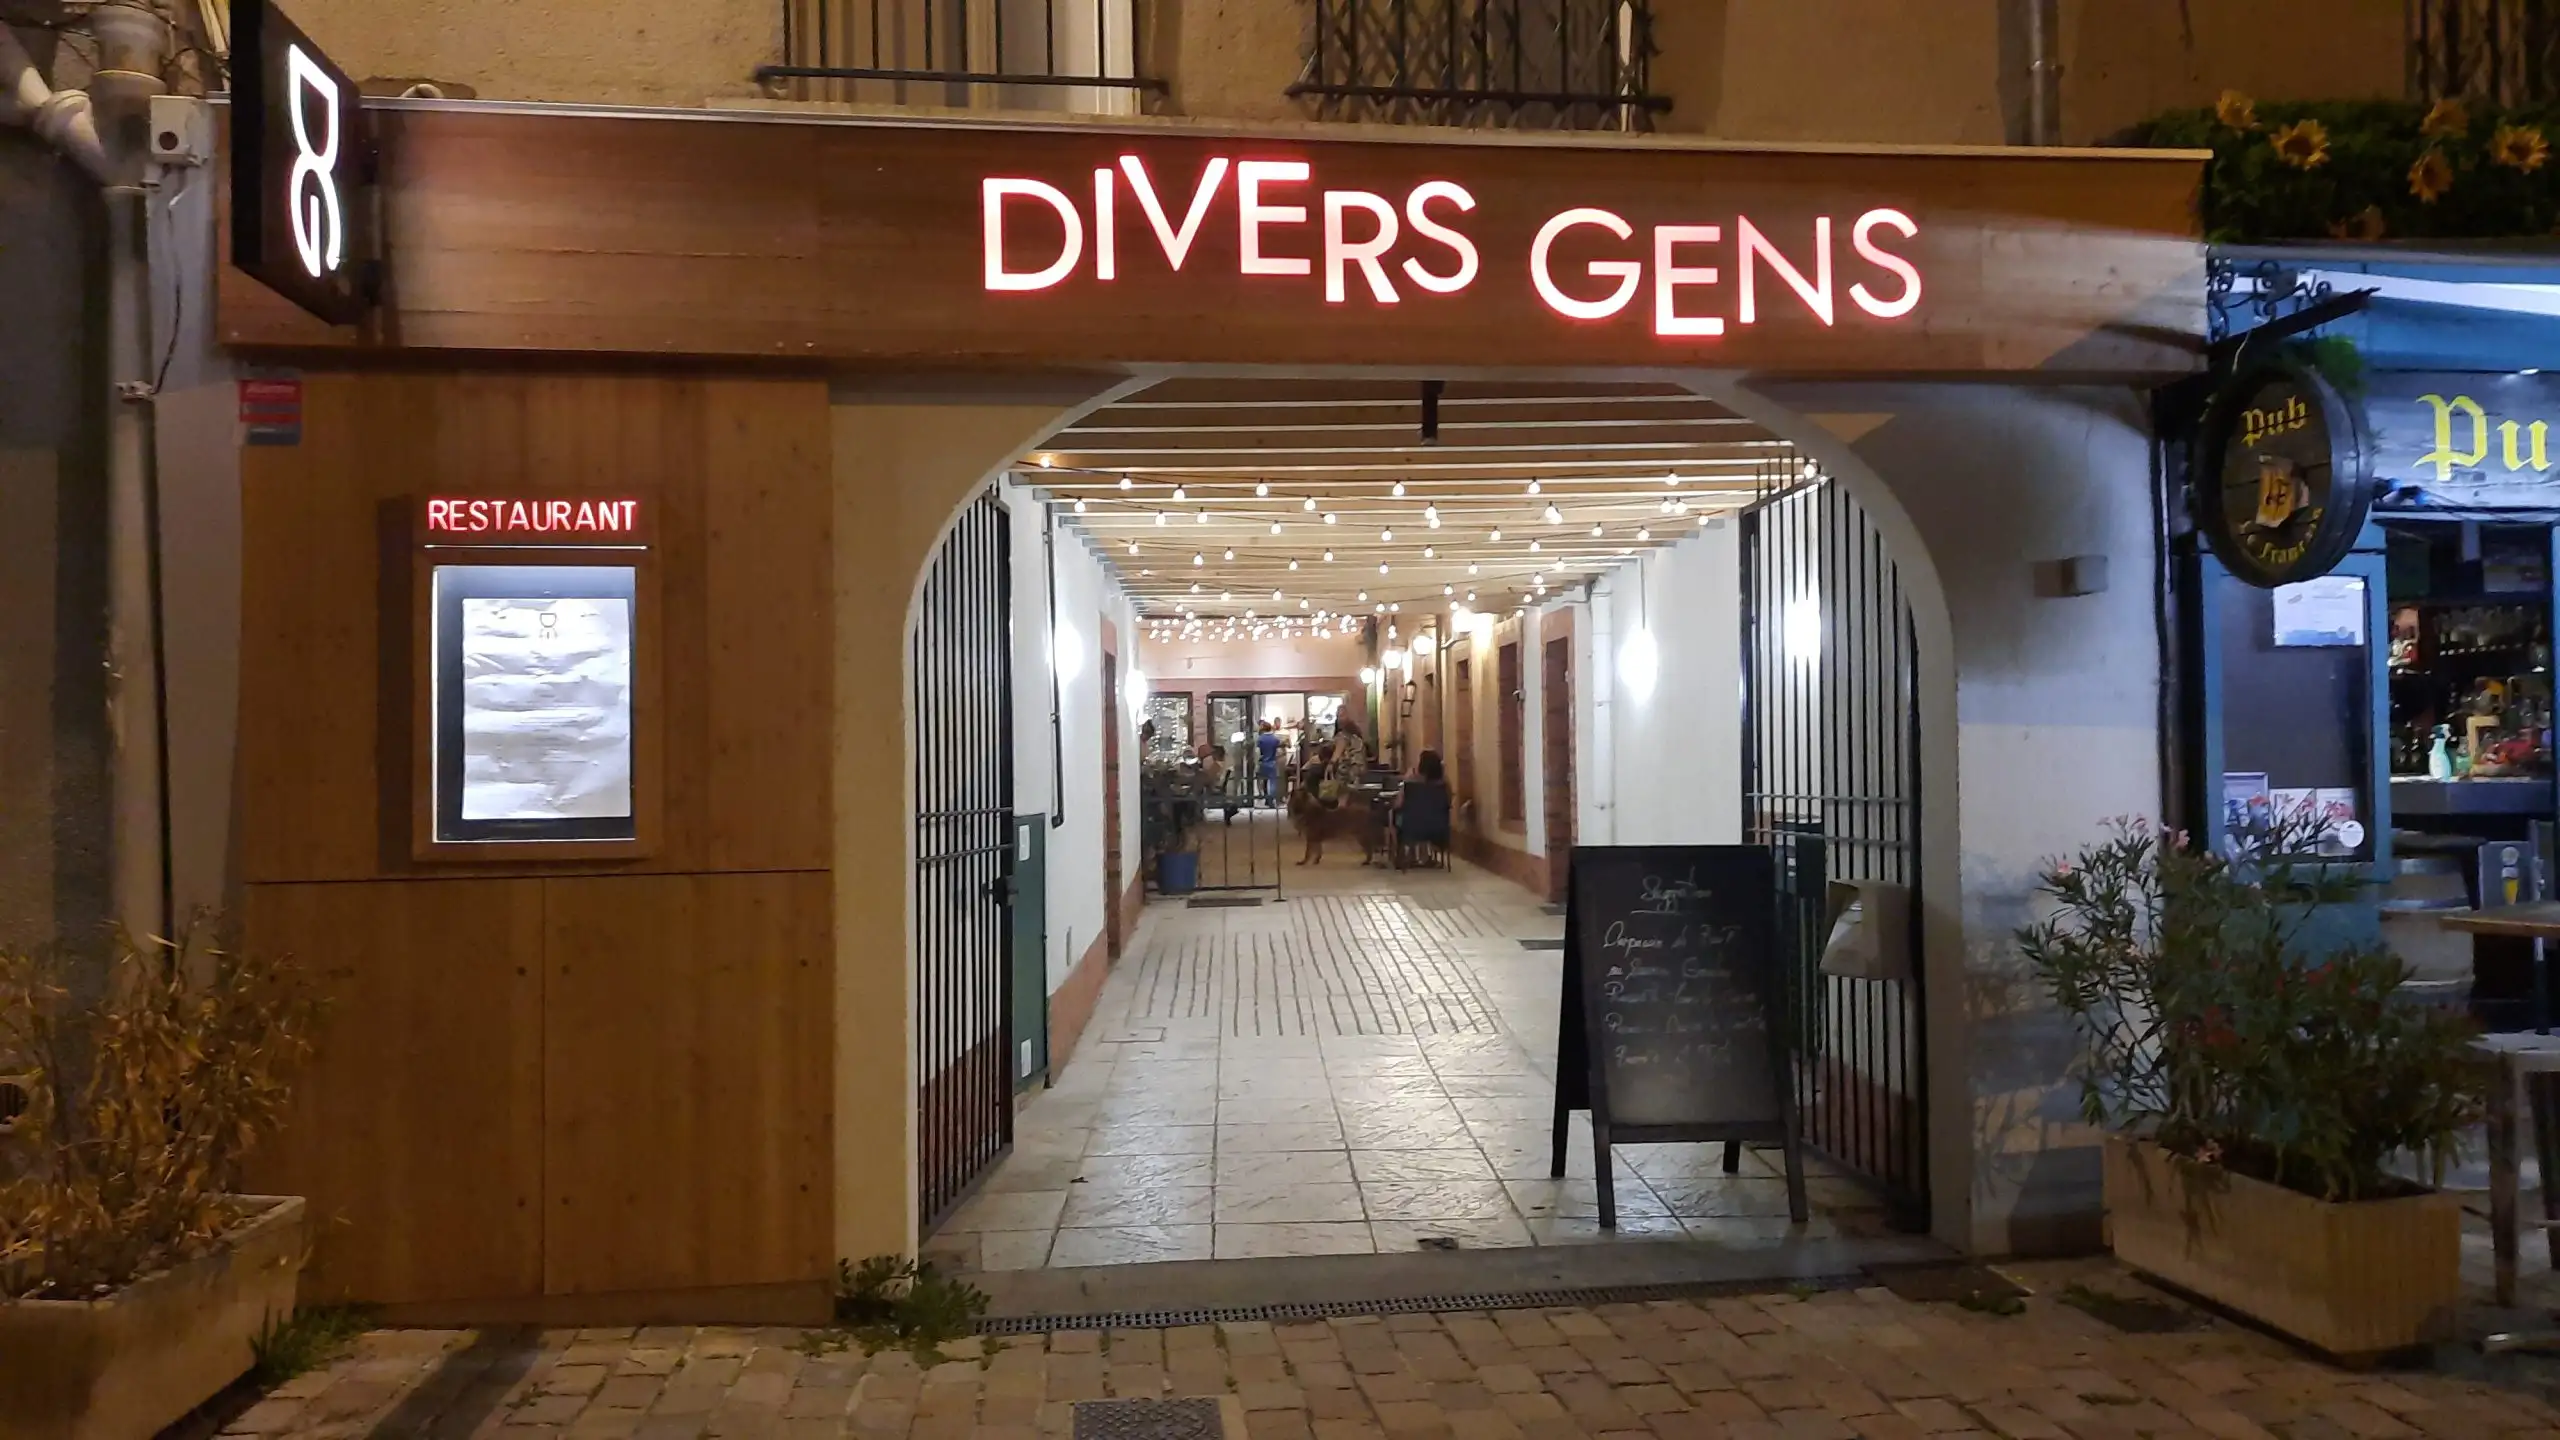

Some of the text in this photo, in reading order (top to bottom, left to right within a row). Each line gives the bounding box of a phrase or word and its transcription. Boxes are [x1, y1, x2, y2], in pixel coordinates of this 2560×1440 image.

[982, 155, 1924, 338] DIVERS GENS
[2241, 395, 2308, 448] Pub
[428, 499, 639, 533] RESTAURANT
